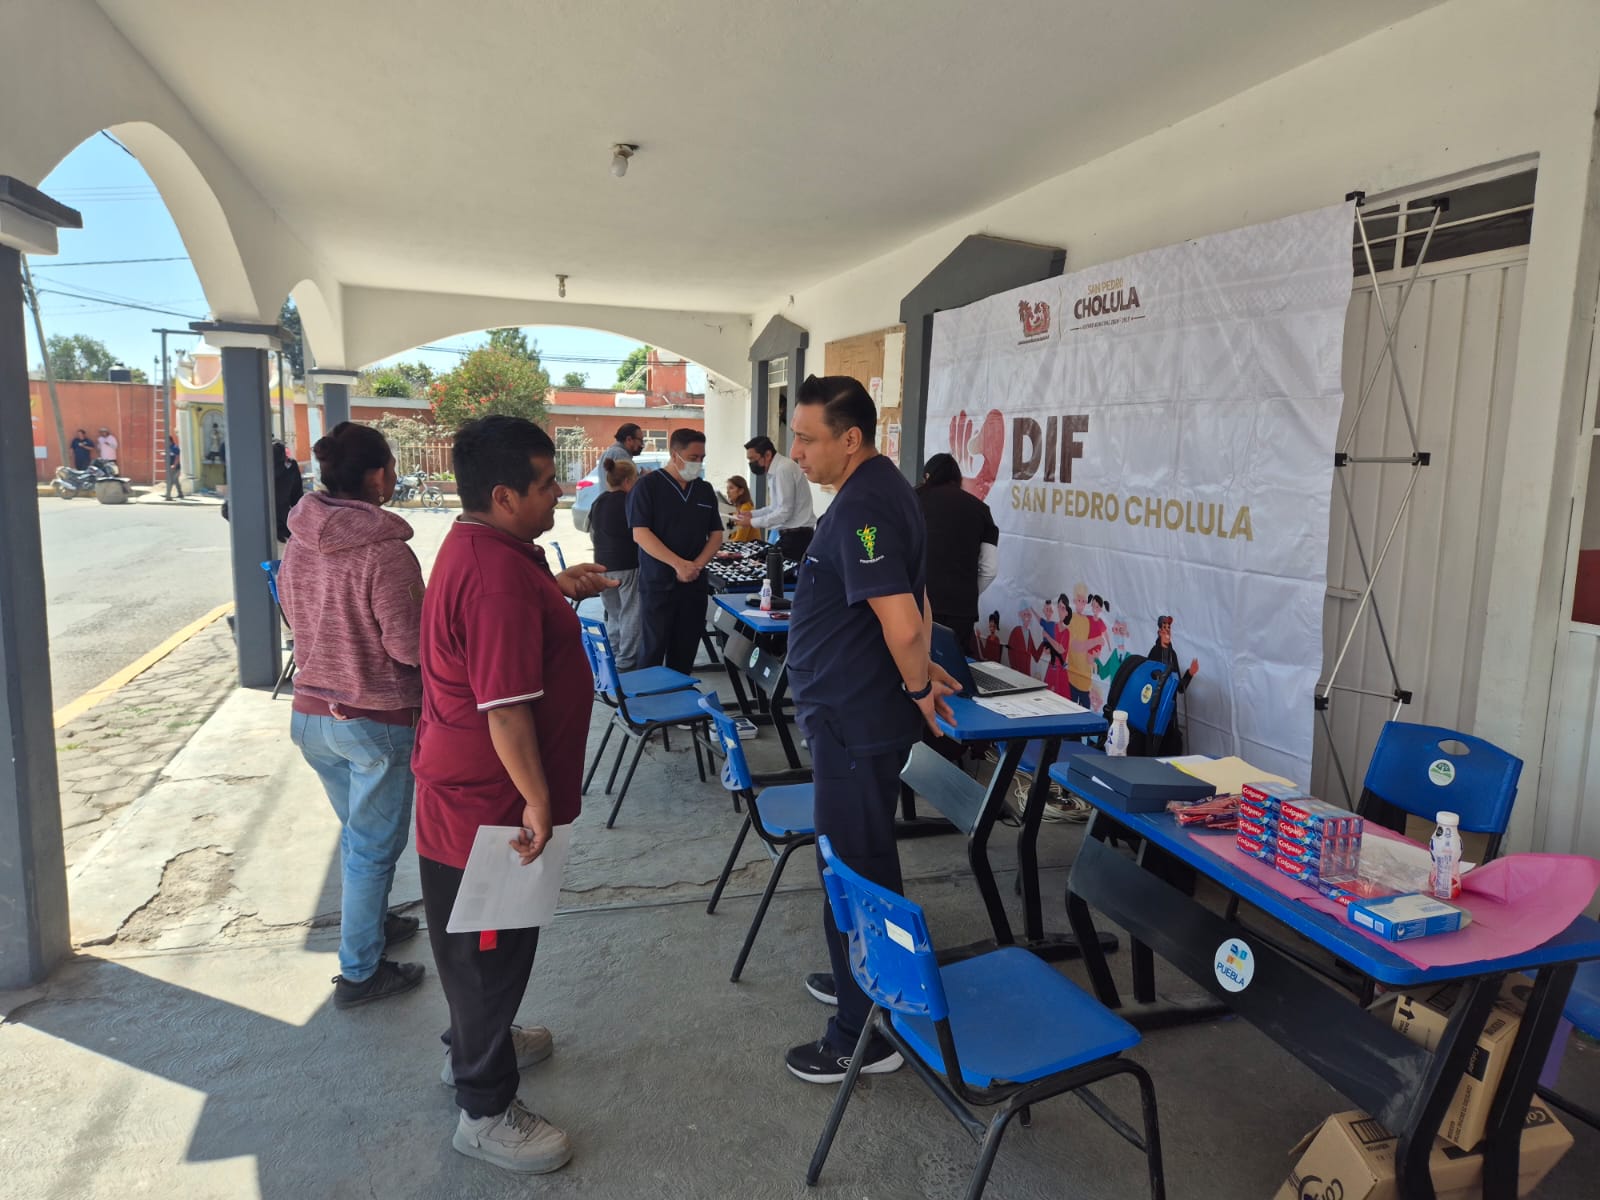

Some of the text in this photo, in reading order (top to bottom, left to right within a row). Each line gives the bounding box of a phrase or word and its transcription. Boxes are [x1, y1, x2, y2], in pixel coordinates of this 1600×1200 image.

[1074, 286, 1140, 320] CHOLULA
[1012, 415, 1089, 484] DIF
[1012, 485, 1254, 542] SAN PEDRO CHOLULA
[1242, 787, 1264, 801] Colgate
[1240, 803, 1262, 817] Colgate
[1281, 805, 1306, 820] Colgate
[1239, 820, 1261, 834] Colgate
[1237, 836, 1259, 850] Colgate
[1278, 839, 1302, 854] Colgate
[1277, 857, 1301, 873] Colgate
[1216, 962, 1245, 988] PUEBLA
